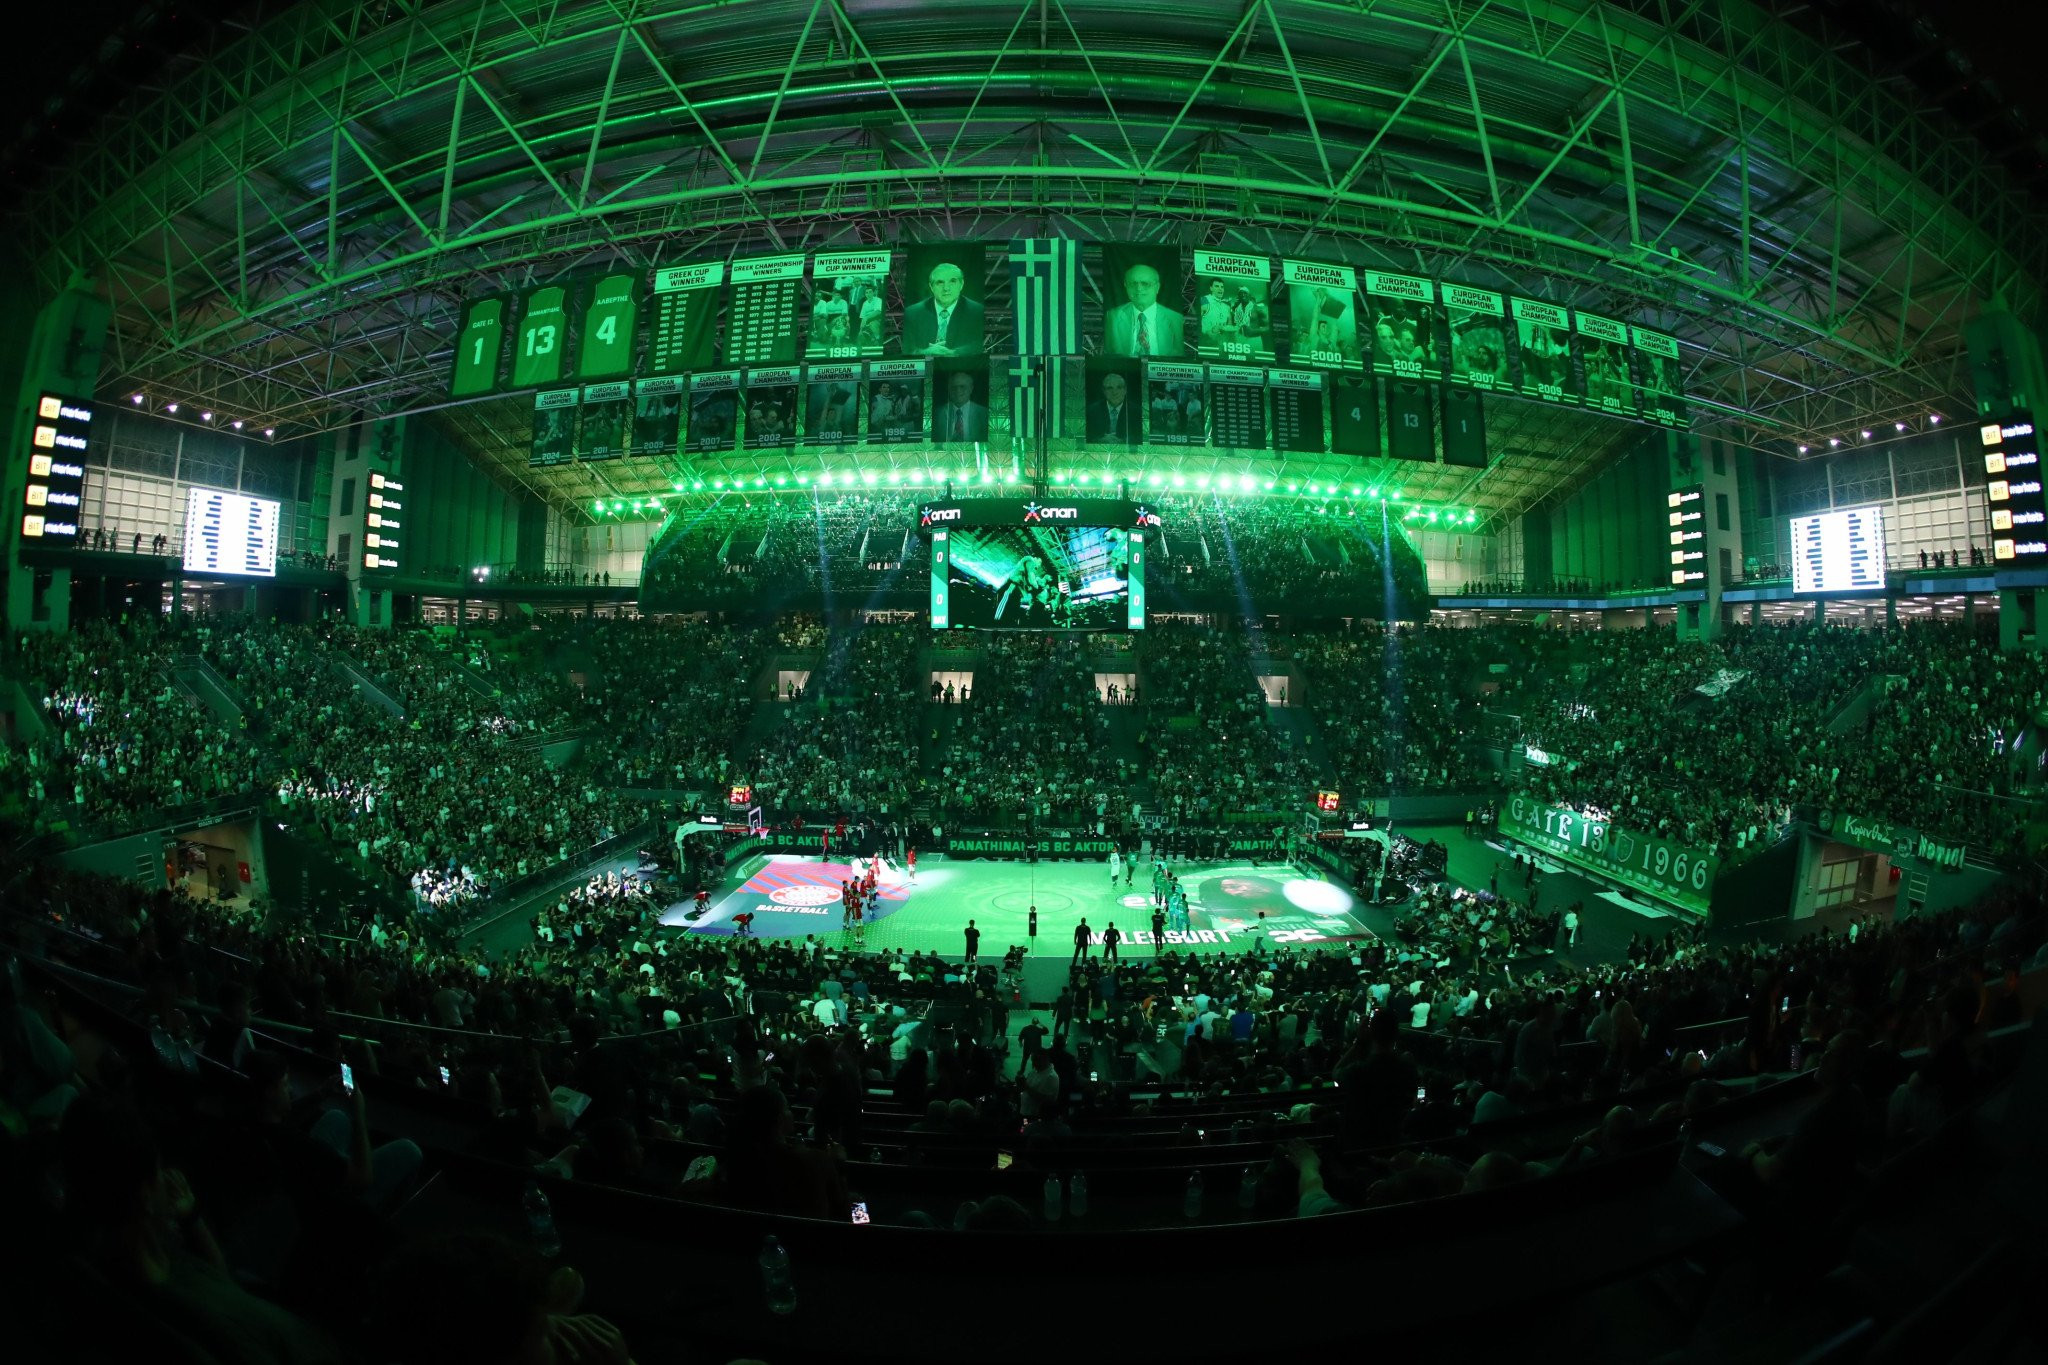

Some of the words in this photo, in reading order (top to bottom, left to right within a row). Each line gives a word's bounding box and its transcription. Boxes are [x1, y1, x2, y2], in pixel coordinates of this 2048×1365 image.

[734, 264, 756, 273] GREEK
[756, 259, 804, 270] CHAMPIONSHIP
[817, 256, 887, 267] INTERCONTINENTAL
[1209, 256, 1256, 268] EUROPEAN
[668, 270, 692, 280] GREEK
[694, 268, 710, 277] CUP
[752, 269, 782, 277] WINNERS
[825, 264, 840, 273] CUP
[842, 263, 877, 272] WINNERS
[1205, 264, 1260, 277] CHAMPIONS
[1297, 266, 1342, 278] EUROPEAN
[671, 277, 706, 287] WINNERS
[1294, 273, 1346, 287] CHAMPIONS
[1378, 276, 1420, 290] EUROPEAN
[1375, 284, 1424, 298] CHAMPIONS
[1453, 289, 1492, 303] EUROPEAN
[1451, 297, 1496, 311] CHAMPIONS
[1522, 303, 1558, 318] EUROPEAN
[1520, 310, 1561, 325] CHAMPIONS
[594, 315, 617, 345] 4
[1585, 317, 1618, 332] EUROPEAN
[1584, 325, 1620, 340] CHAMPIONS
[526, 325, 556, 357] 13
[1641, 332, 1670, 346] EUROPEAN
[473, 337, 484, 366] 1
[830, 346, 858, 358] 1996
[1223, 341, 1251, 354] 1996
[1640, 340, 1674, 354] CHAMPIONS
[1311, 350, 1342, 363] 2000
[818, 367, 851, 376] EUROPEAN
[880, 363, 915, 372] EUROPEAN
[1393, 359, 1422, 373] 2002
[700, 374, 731, 383] EUROPEAN
[758, 370, 791, 379] EUROPEAN
[815, 372, 854, 381] CHAMPIONS
[877, 368, 918, 377] CHAMPIONS
[1469, 371, 1494, 385] 2007
[645, 379, 675, 387] EUROPEAN
[697, 379, 732, 388] CHAMPIONS
[755, 376, 793, 384] CHAMPIONS
[592, 385, 621, 394] EUROPEAN
[642, 384, 677, 393] CHAMPIONS
[1538, 383, 1563, 397] 2009
[590, 391, 622, 400] CHAMPIONS
[1603, 396, 1620, 409] 2011
[1350, 407, 1361, 422] 4
[1403, 413, 1419, 428] 13
[1656, 408, 1676, 421] 2024
[1460, 419, 1467, 433] 1
[700, 437, 721, 446] 2007
[758, 434, 781, 443] 2002
[819, 431, 842, 440] 2000
[593, 446, 608, 456] 2011
[643, 441, 664, 450] 2009
[542, 451, 561, 461] 2024
[936, 552, 943, 562] 0
[1133, 553, 1140, 563] 0
[936, 594, 944, 605] 0
[1133, 595, 1141, 606] 0
[778, 835, 793, 846] BC
[1054, 841, 1071, 852] BC
[1074, 841, 1116, 852] AKTOR
[1511, 797, 1572, 842] GATE
[1581, 822, 1605, 853] 13
[1642, 842, 1708, 890] 1966
[756, 904, 829, 915] BASKETBALL
